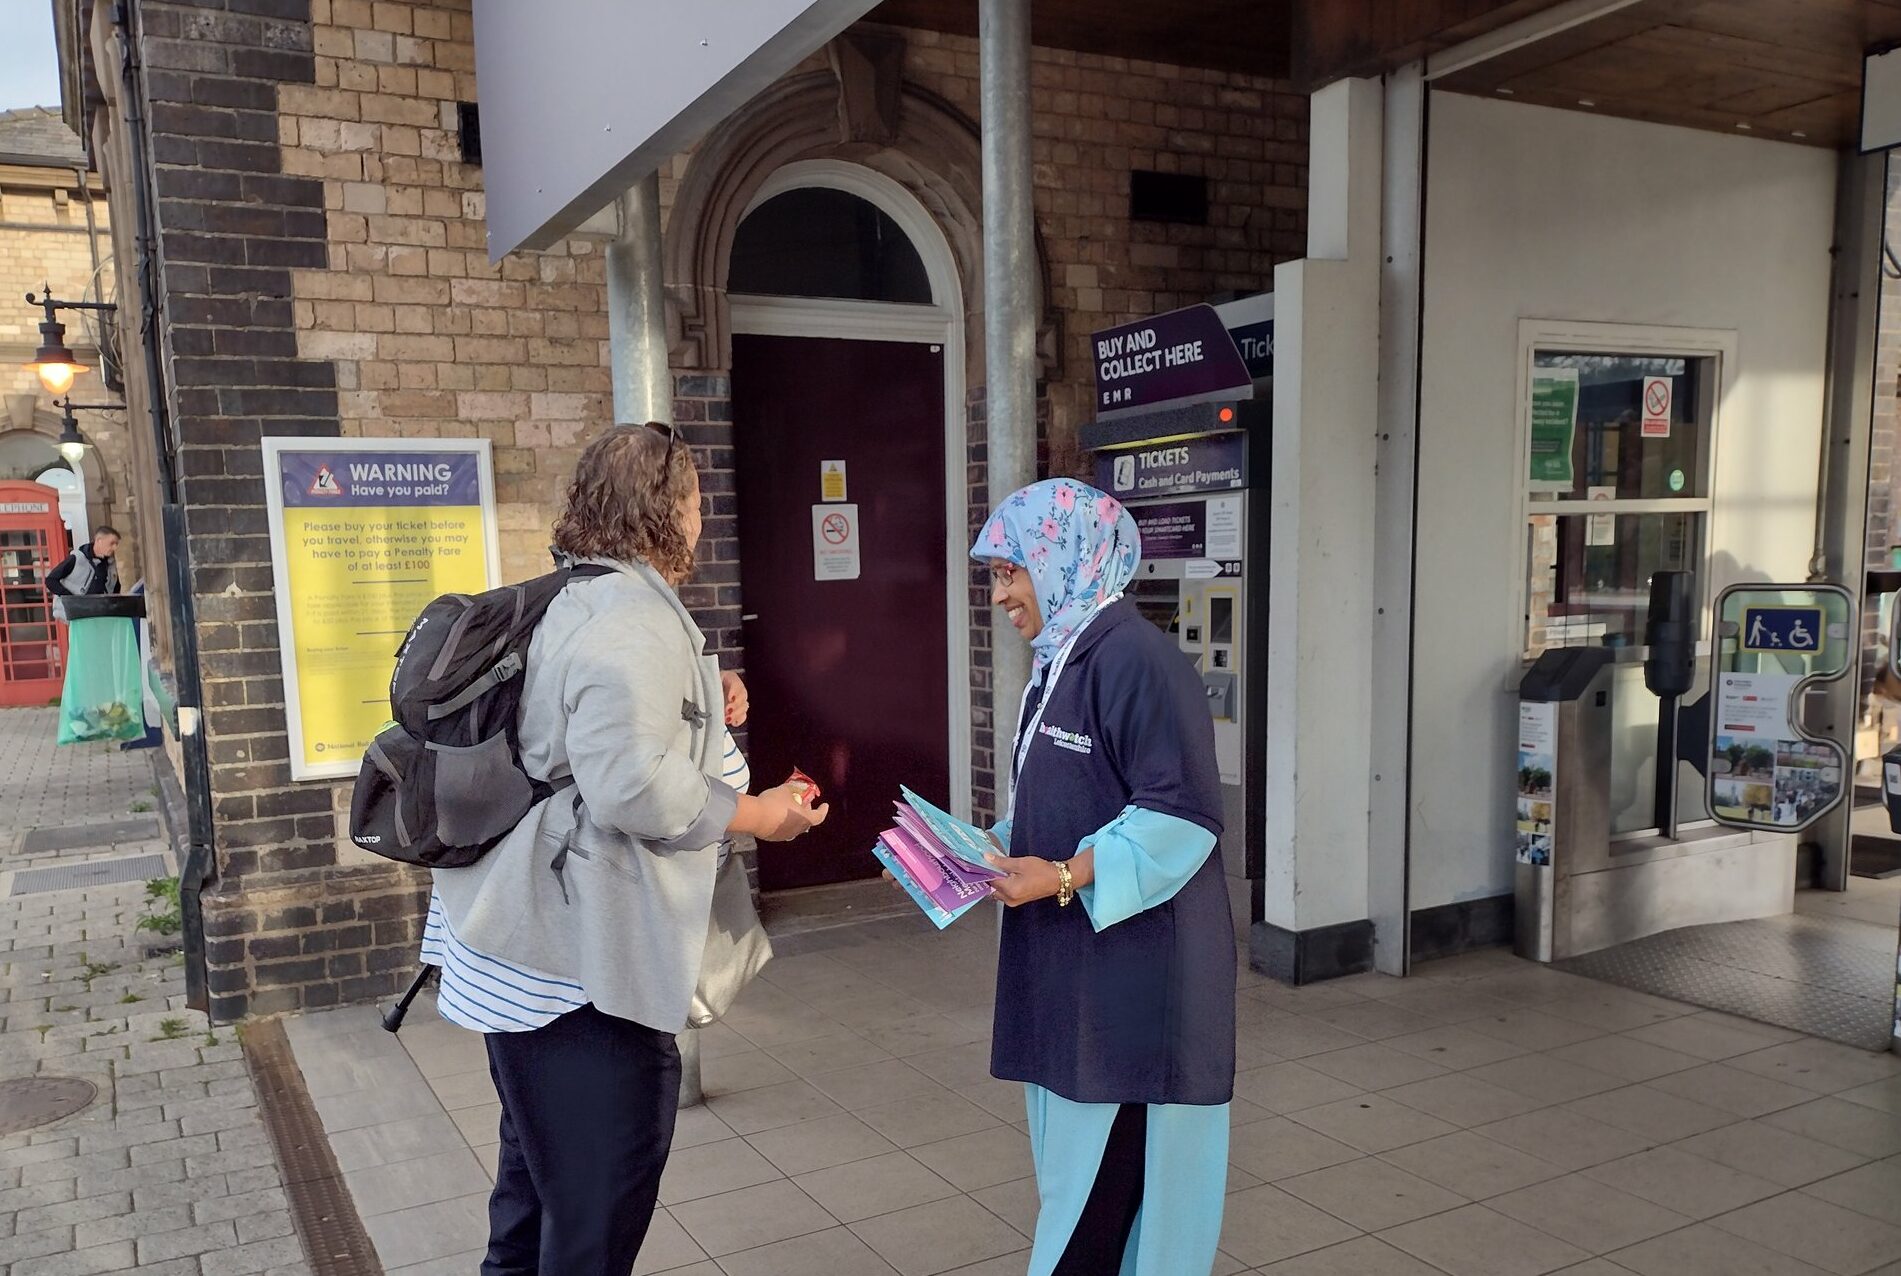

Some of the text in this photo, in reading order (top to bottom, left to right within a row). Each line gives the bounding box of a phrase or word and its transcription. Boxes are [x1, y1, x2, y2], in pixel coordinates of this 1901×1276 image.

[1097, 328, 1157, 360] BUY AND
[1100, 341, 1204, 381] COLLECT HERE
[1139, 446, 1189, 469] TICKETS
[349, 463, 452, 481] WARNING
[1138, 467, 1240, 489] Cash and Card Payments
[351, 484, 449, 498] Have you paid?
[303, 520, 465, 533] Please buy your ticket before
[302, 534, 468, 547] you travel, otherwise you may
[312, 549, 338, 559] have
[344, 550, 355, 558] to
[358, 551, 380, 560] pay
[394, 547, 434, 559] Penalty
[437, 547, 461, 556] Fare
[347, 560, 430, 571] of at least £100
